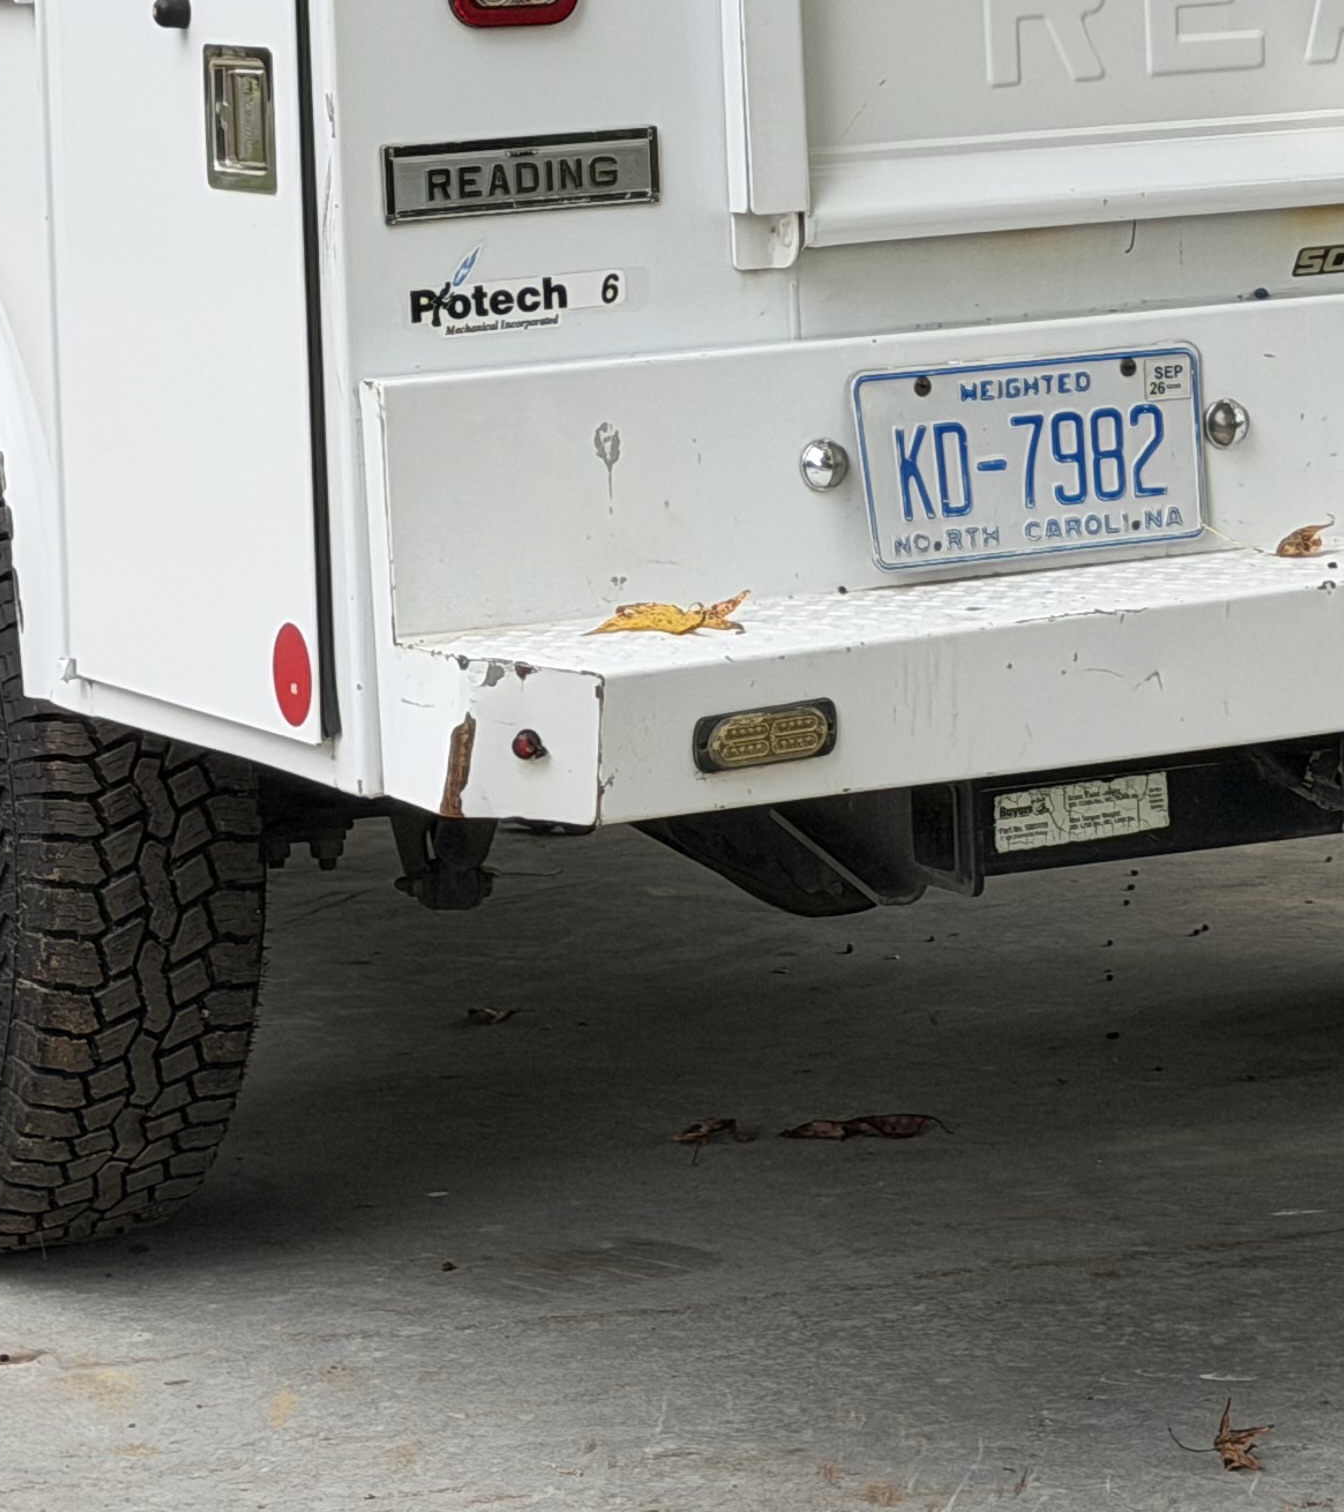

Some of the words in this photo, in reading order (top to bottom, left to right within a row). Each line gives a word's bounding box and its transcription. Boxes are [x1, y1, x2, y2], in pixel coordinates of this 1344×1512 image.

[426, 156, 619, 202] READING
[410, 276, 568, 327] Protech
[600, 273, 620, 305] 6
[445, 319, 499, 336] Mechanical
[959, 371, 1091, 403] WEIGHTED
[1154, 364, 1183, 380] SEP
[893, 403, 1168, 522] KD-7982
[894, 527, 1000, 558] NORTH
[1024, 506, 1184, 543] CAROLINA
